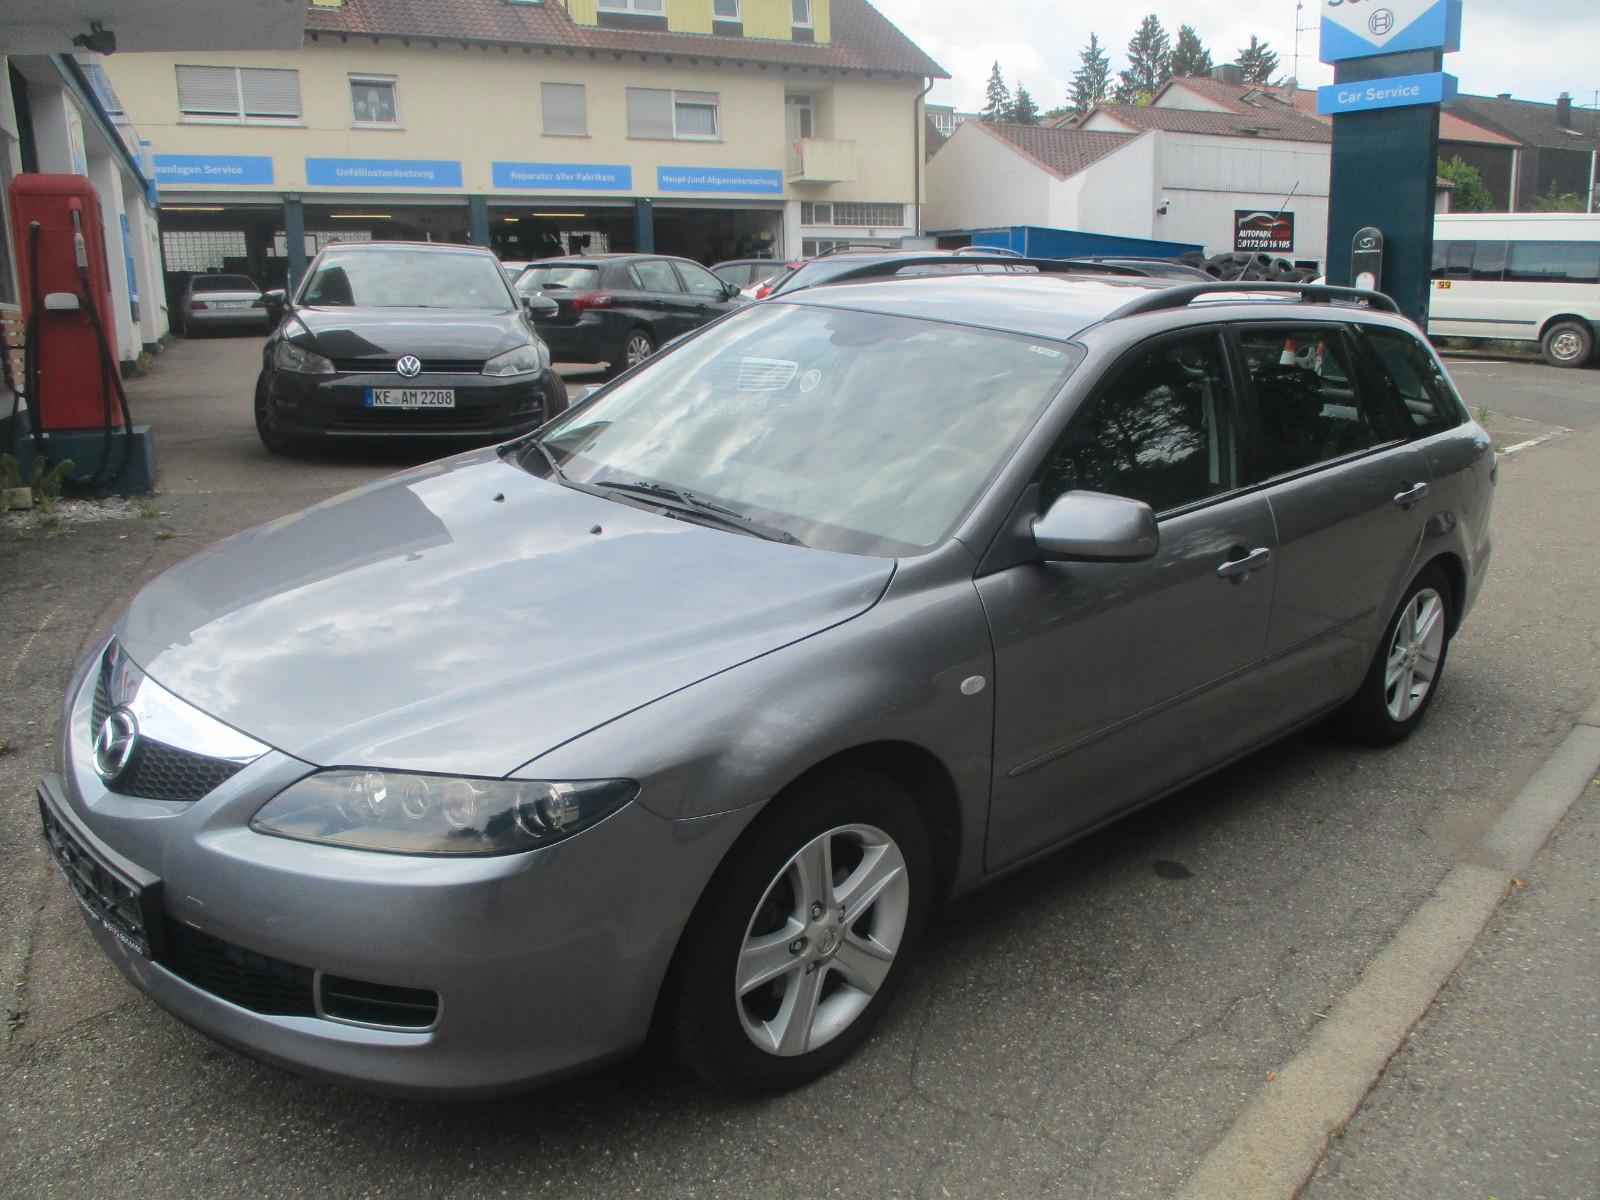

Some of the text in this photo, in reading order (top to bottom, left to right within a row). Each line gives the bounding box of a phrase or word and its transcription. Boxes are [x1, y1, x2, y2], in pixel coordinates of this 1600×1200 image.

[1337, 86, 1420, 104] Car Service
[205, 165, 243, 174] Service
[556, 172, 574, 181] aller
[1238, 230, 1272, 238] AUTOPARK
[1242, 240, 1258, 248] 0172
[375, 391, 391, 404] KE
[401, 391, 418, 405] AM
[421, 391, 452, 405] 2208
